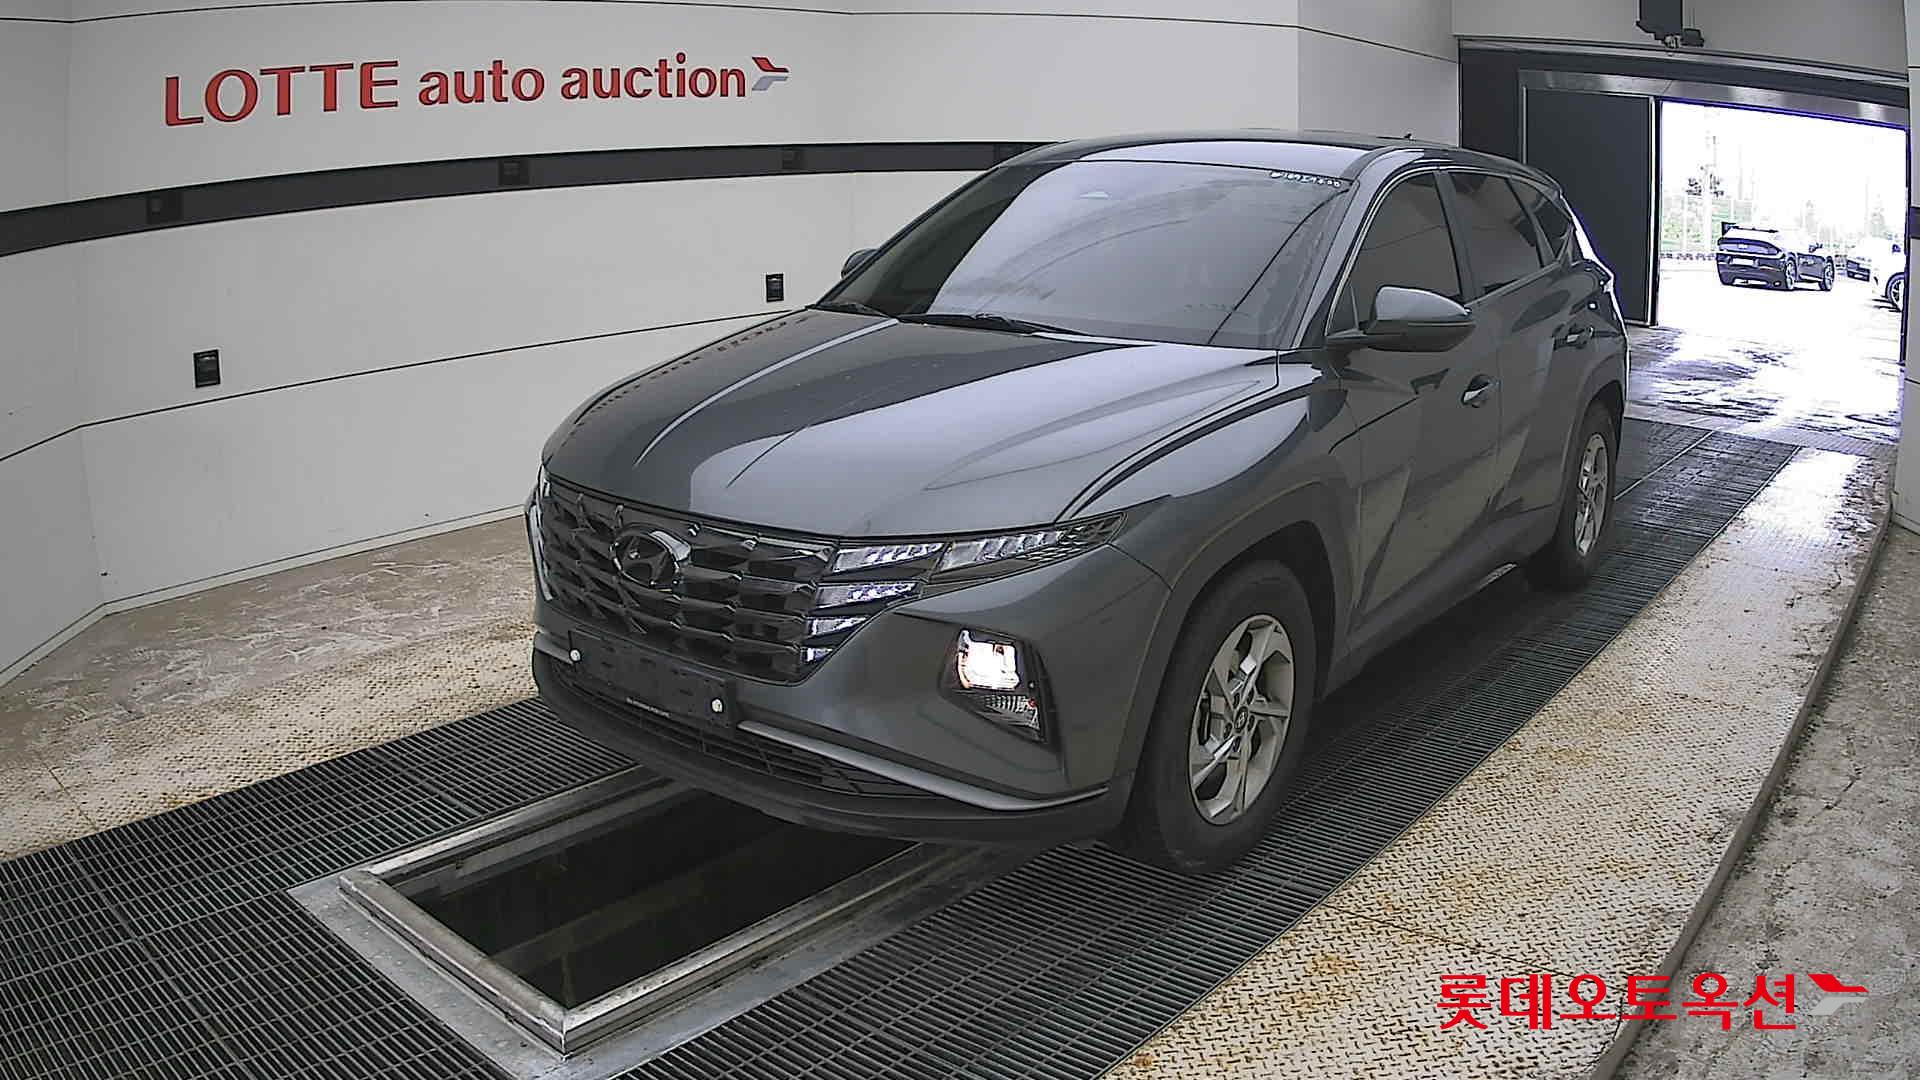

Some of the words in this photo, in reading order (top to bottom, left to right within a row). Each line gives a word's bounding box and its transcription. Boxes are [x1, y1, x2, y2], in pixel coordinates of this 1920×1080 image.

[164, 60, 399, 127] LOTTE
[418, 59, 546, 106] auto
[560, 52, 747, 101] auction
